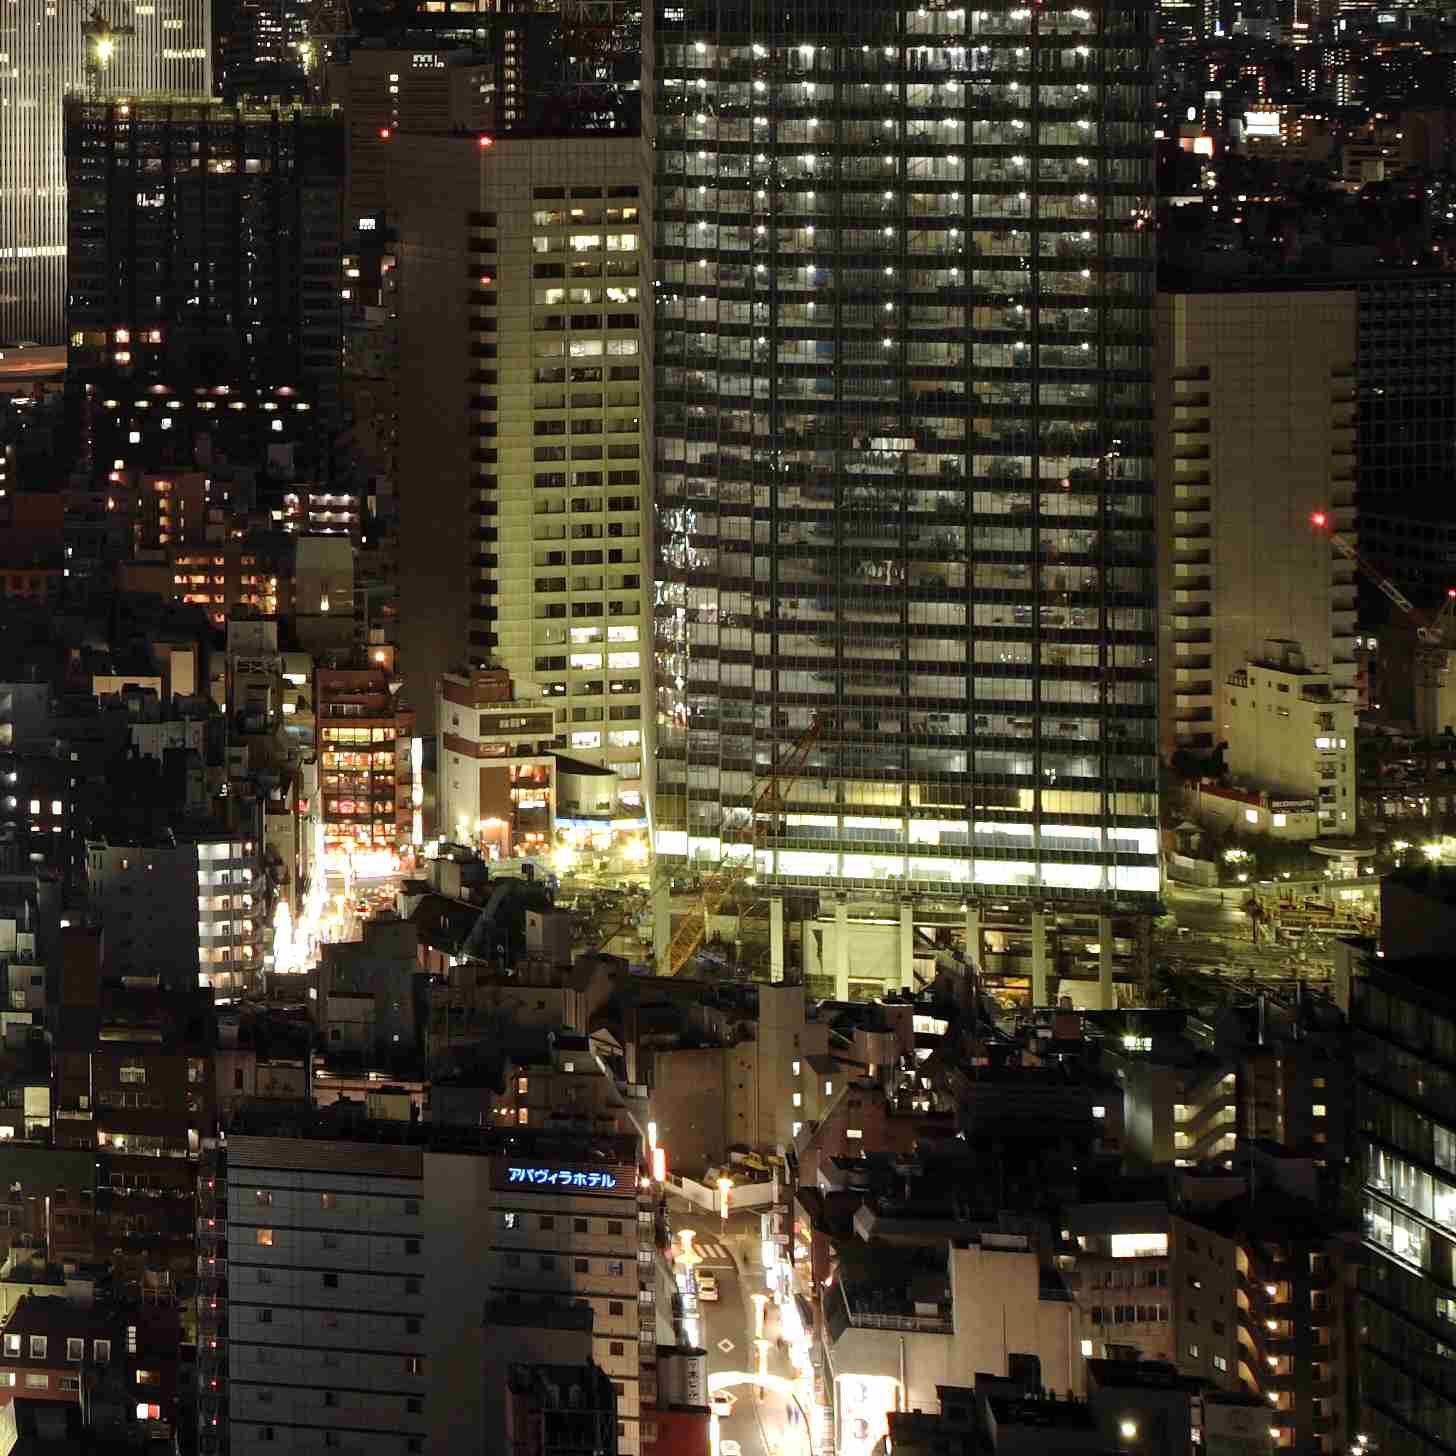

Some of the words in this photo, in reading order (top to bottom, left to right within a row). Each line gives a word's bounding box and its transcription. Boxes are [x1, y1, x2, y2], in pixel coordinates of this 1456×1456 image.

[507, 1167, 617, 1188] アパヴィラホテル
